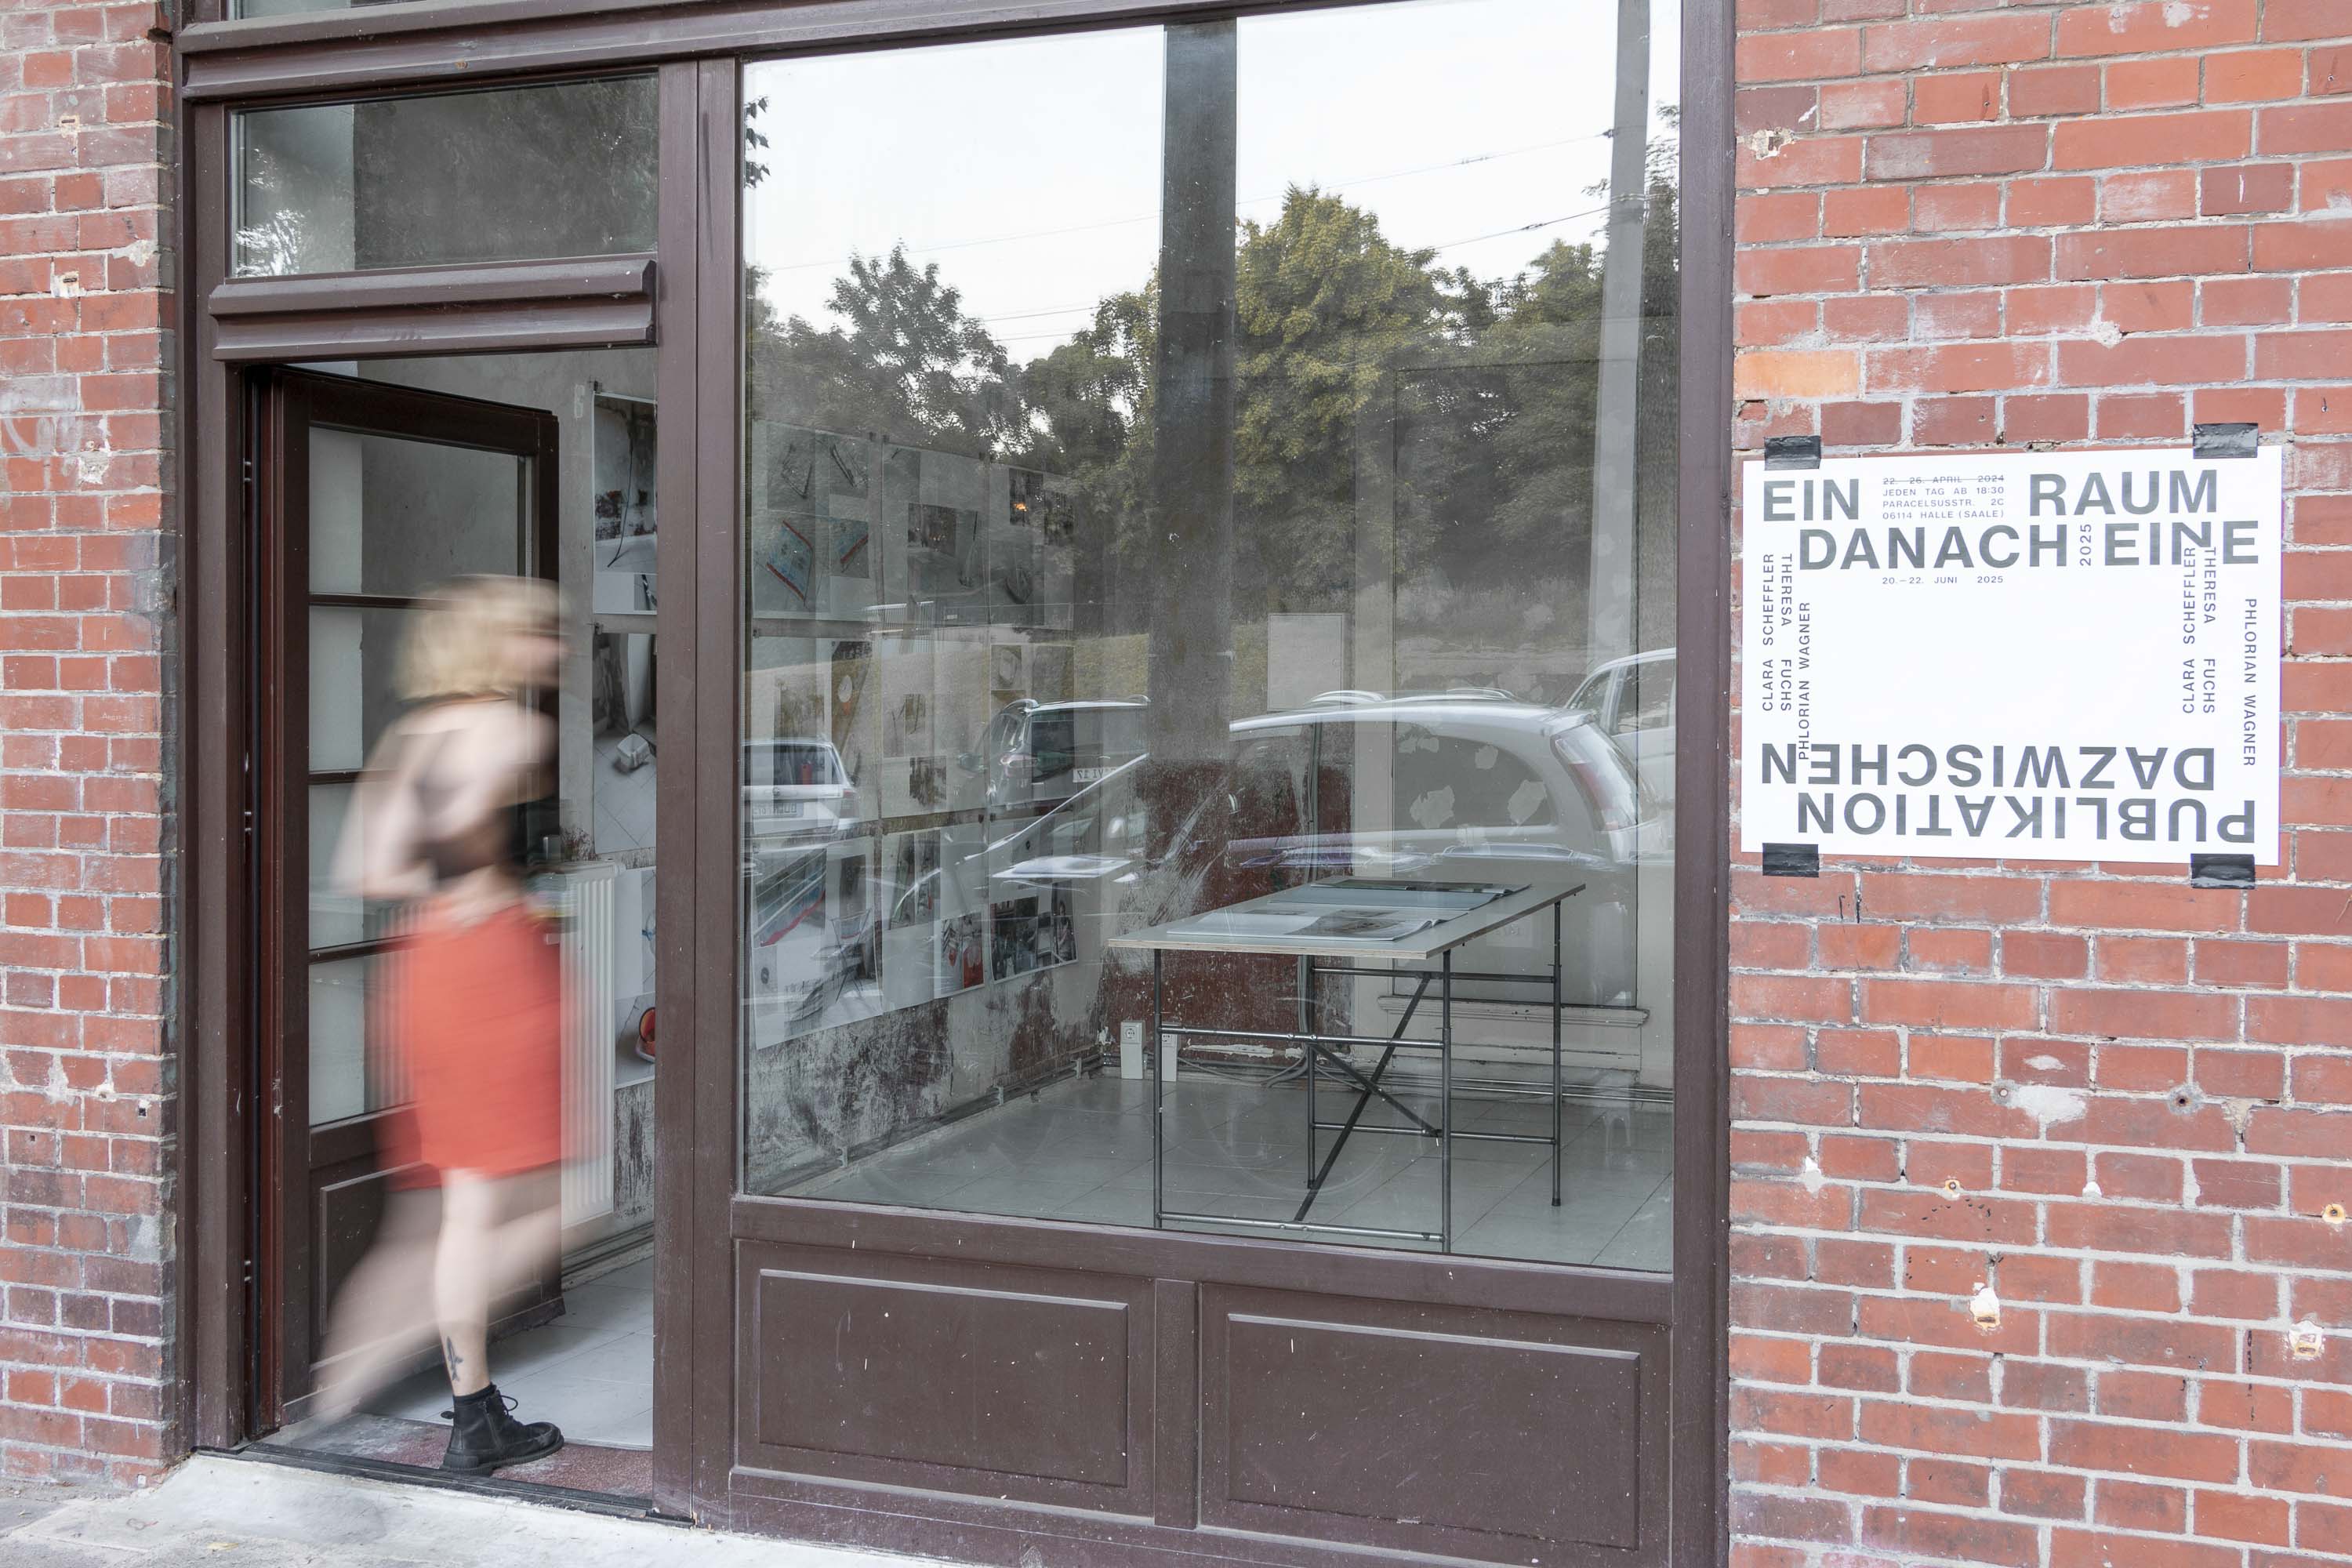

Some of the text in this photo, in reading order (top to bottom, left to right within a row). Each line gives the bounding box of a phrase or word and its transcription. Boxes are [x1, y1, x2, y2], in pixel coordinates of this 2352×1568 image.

[1764, 470, 2216, 521] EIN RAUM
[1976, 474, 2005, 483] 2024
[1976, 486, 2004, 495] 18:30
[1920, 510, 1954, 519] HALLE
[1800, 521, 2258, 570] DANACH EINE
[2078, 524, 2092, 567] 2025
[1976, 575, 2004, 584] 2025
[1762, 554, 1774, 712] CLARA SCHEFFLER
[1780, 553, 1793, 712] THERESA FUCHS
[2182, 547, 2196, 714] CLARA SCHEFFLER
[2202, 546, 2216, 713] THERESA FUCHS
[1798, 602, 1811, 760] PHLORIAN WAGNER
[2243, 598, 2257, 766] PHLORIAN WAGNER
[1762, 743, 2215, 791] DAZWISCHEN
[1798, 793, 2255, 842] PUBLIKATION
